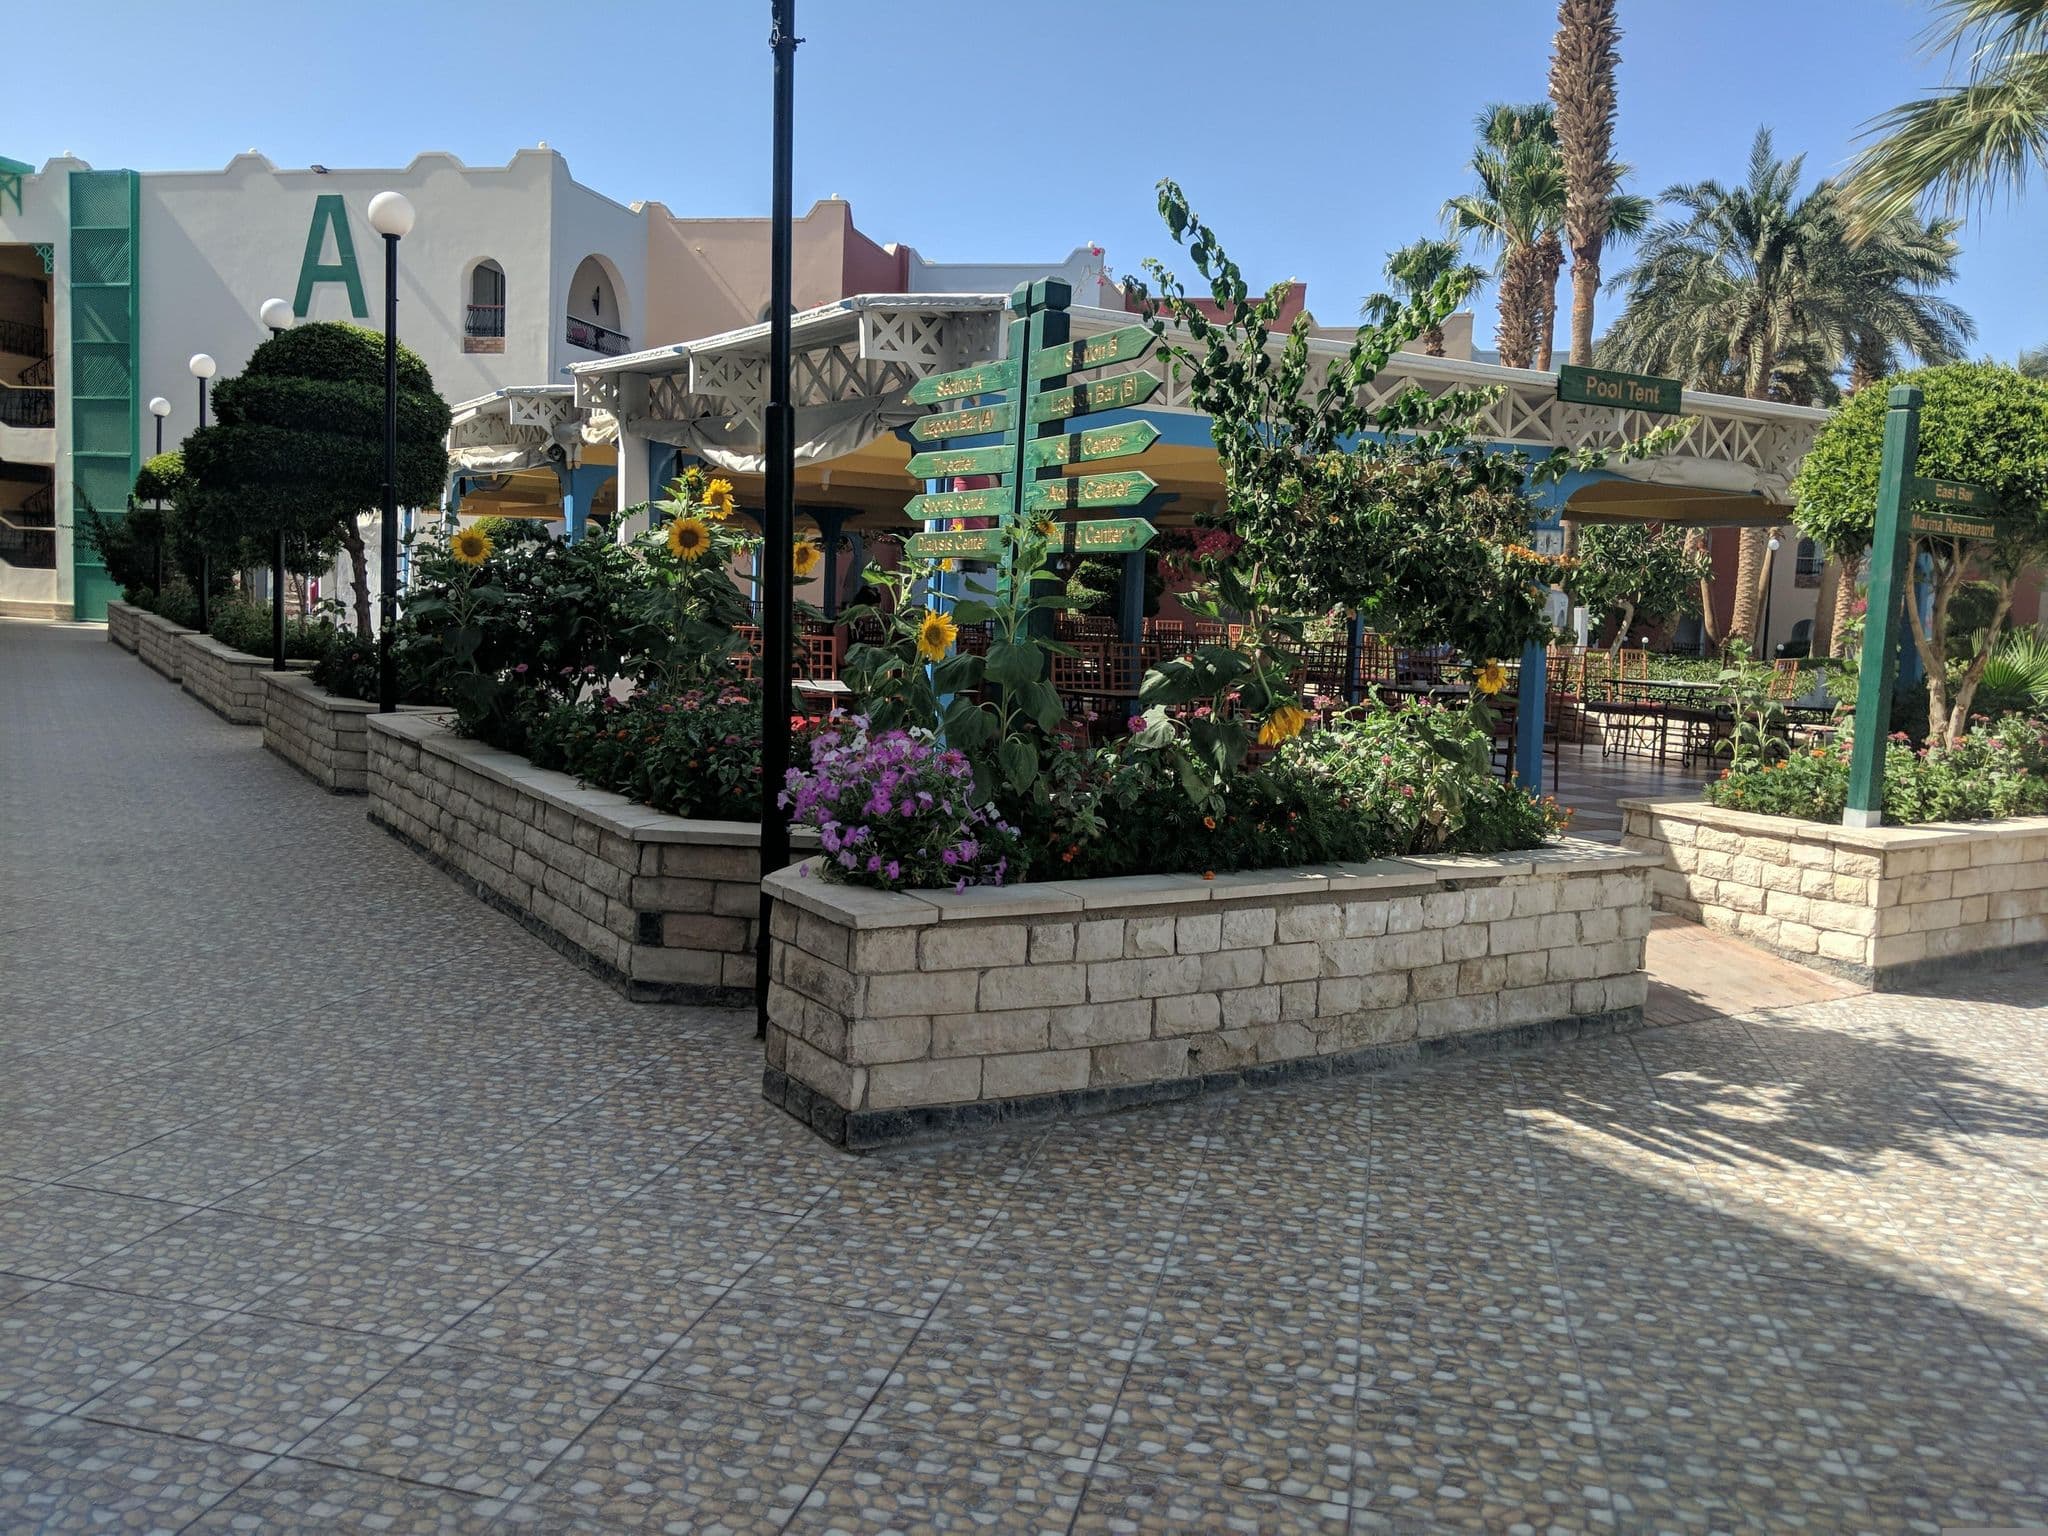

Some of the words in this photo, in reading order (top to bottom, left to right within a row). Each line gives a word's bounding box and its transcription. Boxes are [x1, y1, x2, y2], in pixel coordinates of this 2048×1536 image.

[293, 194, 369, 318] A
[1064, 344, 1106, 367] Section
[1108, 336, 1119, 357] B
[936, 378, 973, 397] Section
[975, 371, 983, 390] A
[1051, 392, 1093, 414] Lagoon
[1096, 384, 1117, 403] Bar
[1120, 376, 1137, 404] (B)
[1585, 375, 1623, 399] Pool
[1627, 380, 1660, 404] Tent
[923, 418, 958, 438] Lagoon
[959, 412, 978, 430] Bar
[979, 408, 993, 432] (A)
[1084, 437, 1124, 455] Center
[932, 456, 976, 473] Theater
[1047, 484, 1080, 506] Aqua
[1084, 480, 1132, 499] Center
[1935, 483, 1957, 499] East
[1959, 487, 1975, 502] Bar
[922, 498, 953, 518] Sports
[955, 495, 987, 511] Center
[1085, 526, 1125, 544] Center
[1945, 518, 1995, 537] Restaurant
[917, 536, 953, 555] Dialysis
[955, 534, 987, 551] Center
